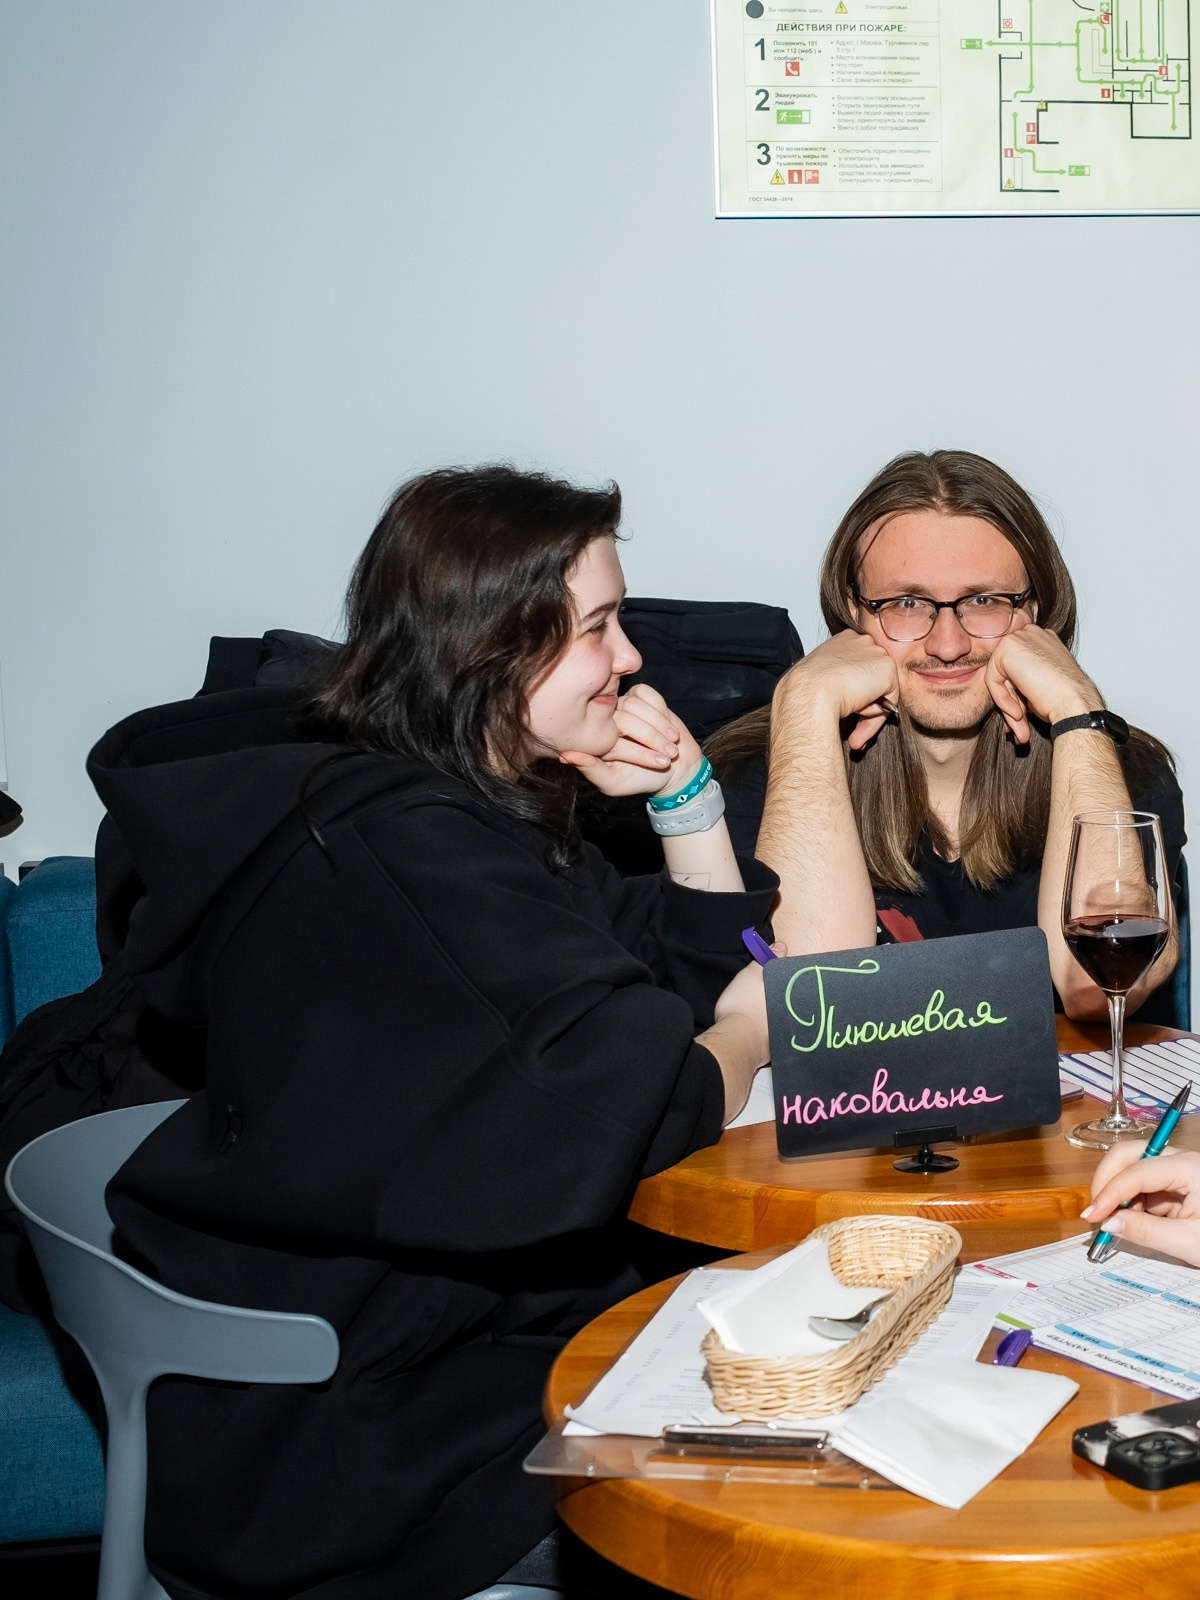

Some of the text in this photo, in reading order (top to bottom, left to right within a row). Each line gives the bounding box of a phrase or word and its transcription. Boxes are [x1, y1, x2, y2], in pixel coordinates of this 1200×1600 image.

[776, 22, 832, 32] ДЕЙСТВИЯ
[860, 24, 906, 32] ПОЖАРЕ:
[755, 38, 765, 60] 1
[755, 88, 770, 111] 2
[757, 143, 771, 165] 3
[785, 959, 1008, 1052] Плюшевая
[782, 1068, 1004, 1124] наковальня
